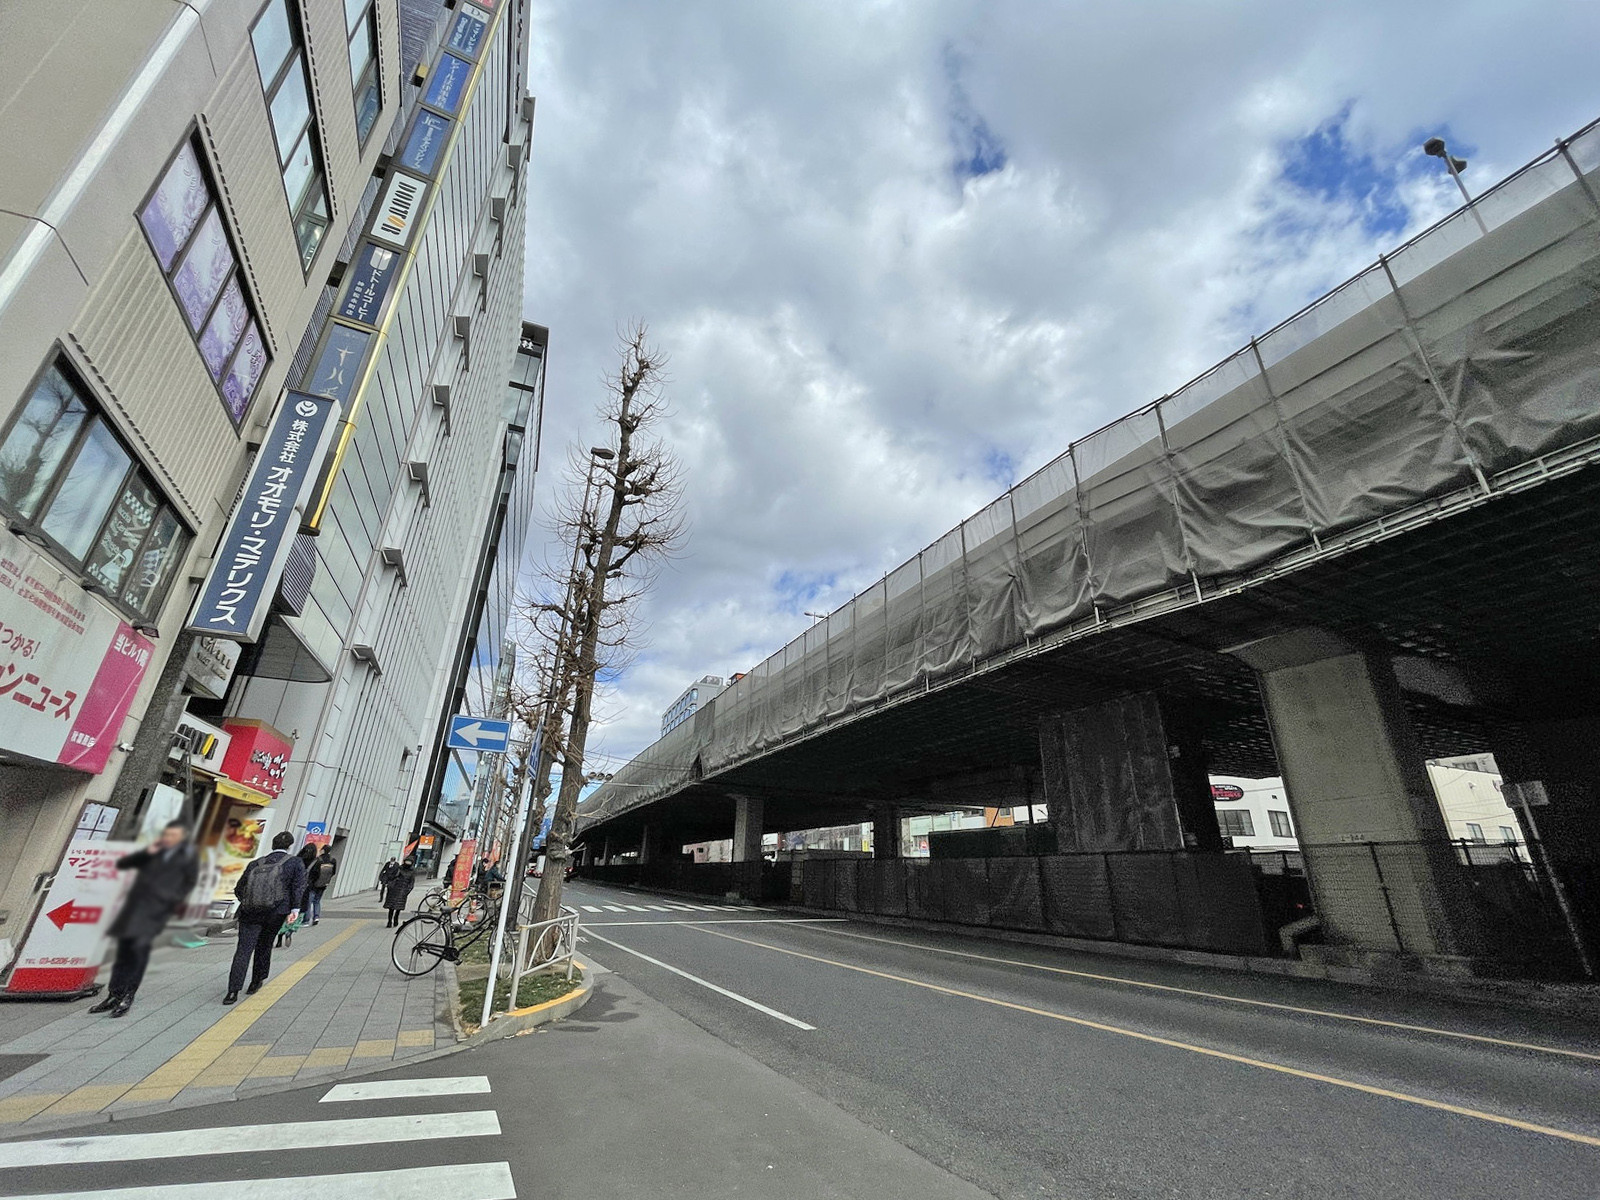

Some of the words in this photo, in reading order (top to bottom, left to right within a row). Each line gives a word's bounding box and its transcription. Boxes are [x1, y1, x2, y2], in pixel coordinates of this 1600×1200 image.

[380, 181, 417, 236] DOUTOR
[358, 268, 383, 321] ドトールコーヒー
[278, 418, 310, 464] 株式会社
[209, 465, 293, 626] オオモリ・マテリクス
[0, 662, 78, 721] ンニュース
